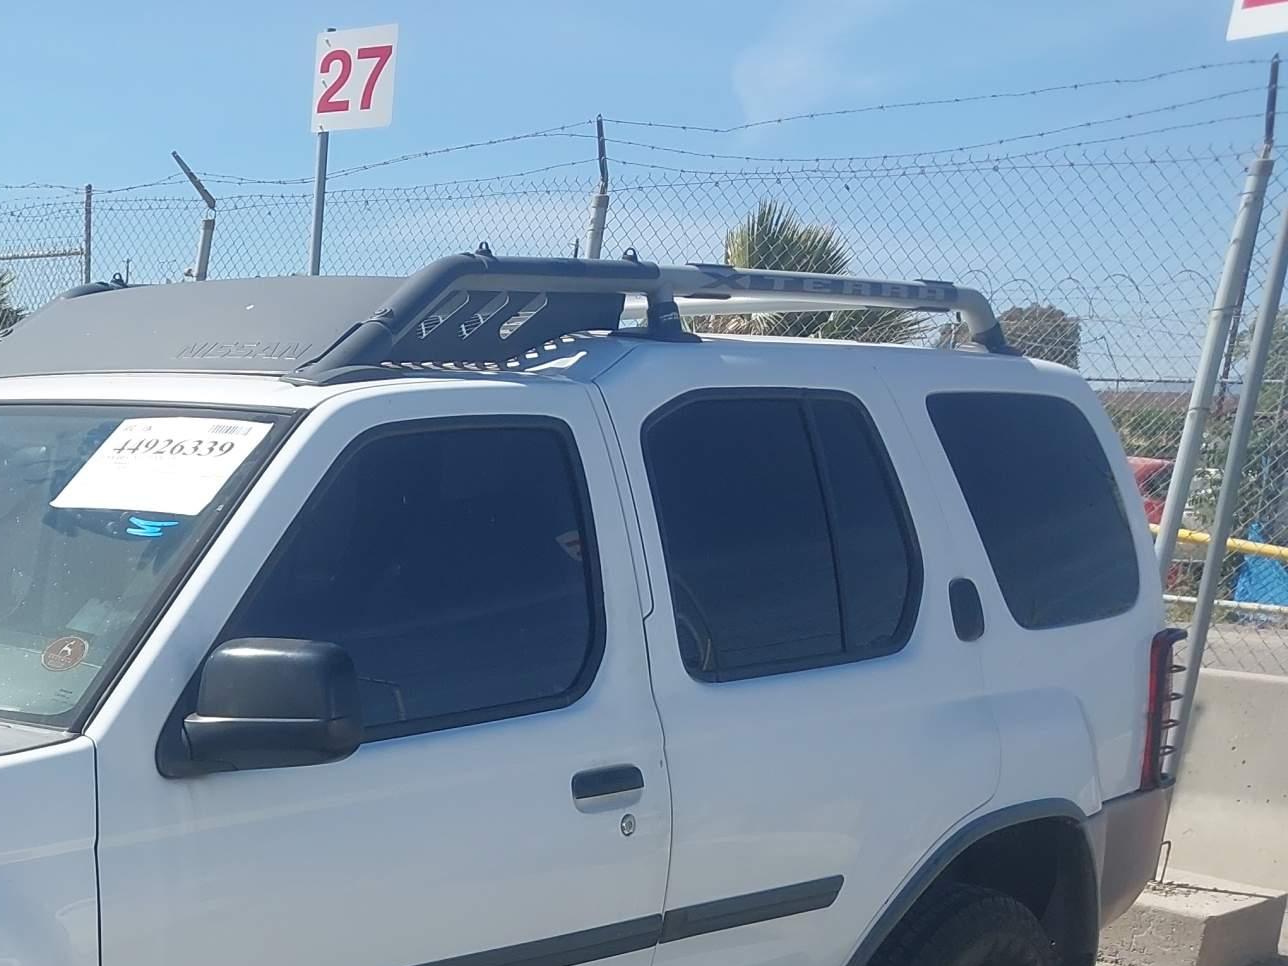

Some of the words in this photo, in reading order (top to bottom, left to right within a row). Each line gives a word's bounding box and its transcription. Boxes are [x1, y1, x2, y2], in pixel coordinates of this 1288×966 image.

[316, 44, 393, 113] 27
[701, 271, 948, 301] XTERRA
[175, 341, 313, 360] NISSAN
[113, 438, 235, 457] 44926339
